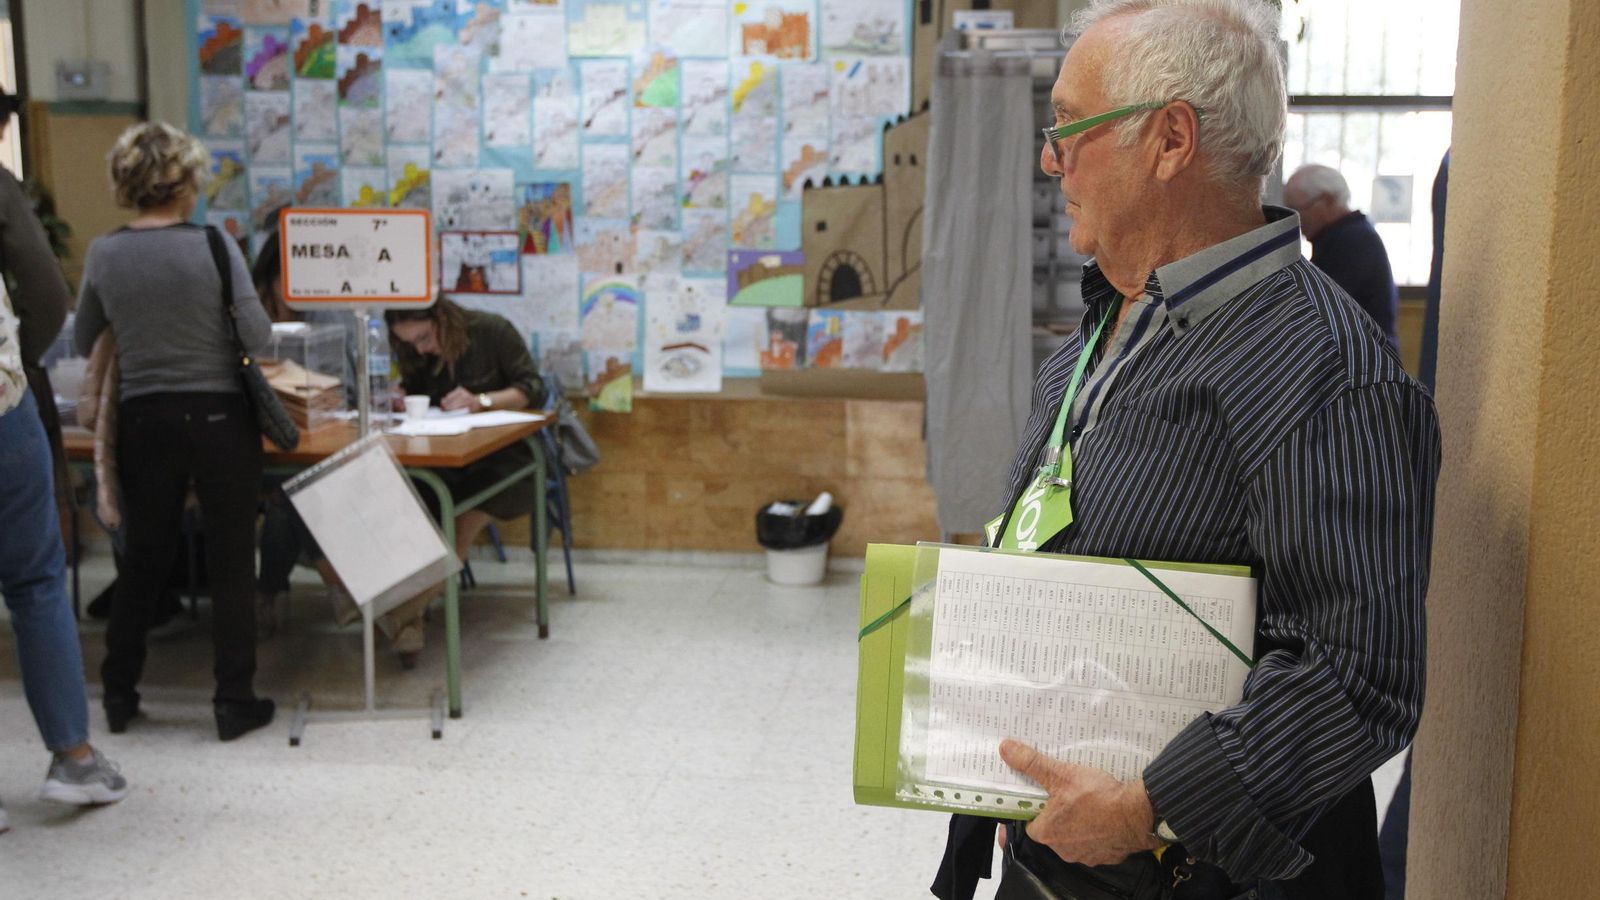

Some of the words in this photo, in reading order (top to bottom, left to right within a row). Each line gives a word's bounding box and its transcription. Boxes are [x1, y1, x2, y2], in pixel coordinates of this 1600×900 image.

[291, 244, 349, 259] MESA
[378, 249, 391, 262] A
[341, 281, 352, 293] A
[390, 281, 399, 293] L
